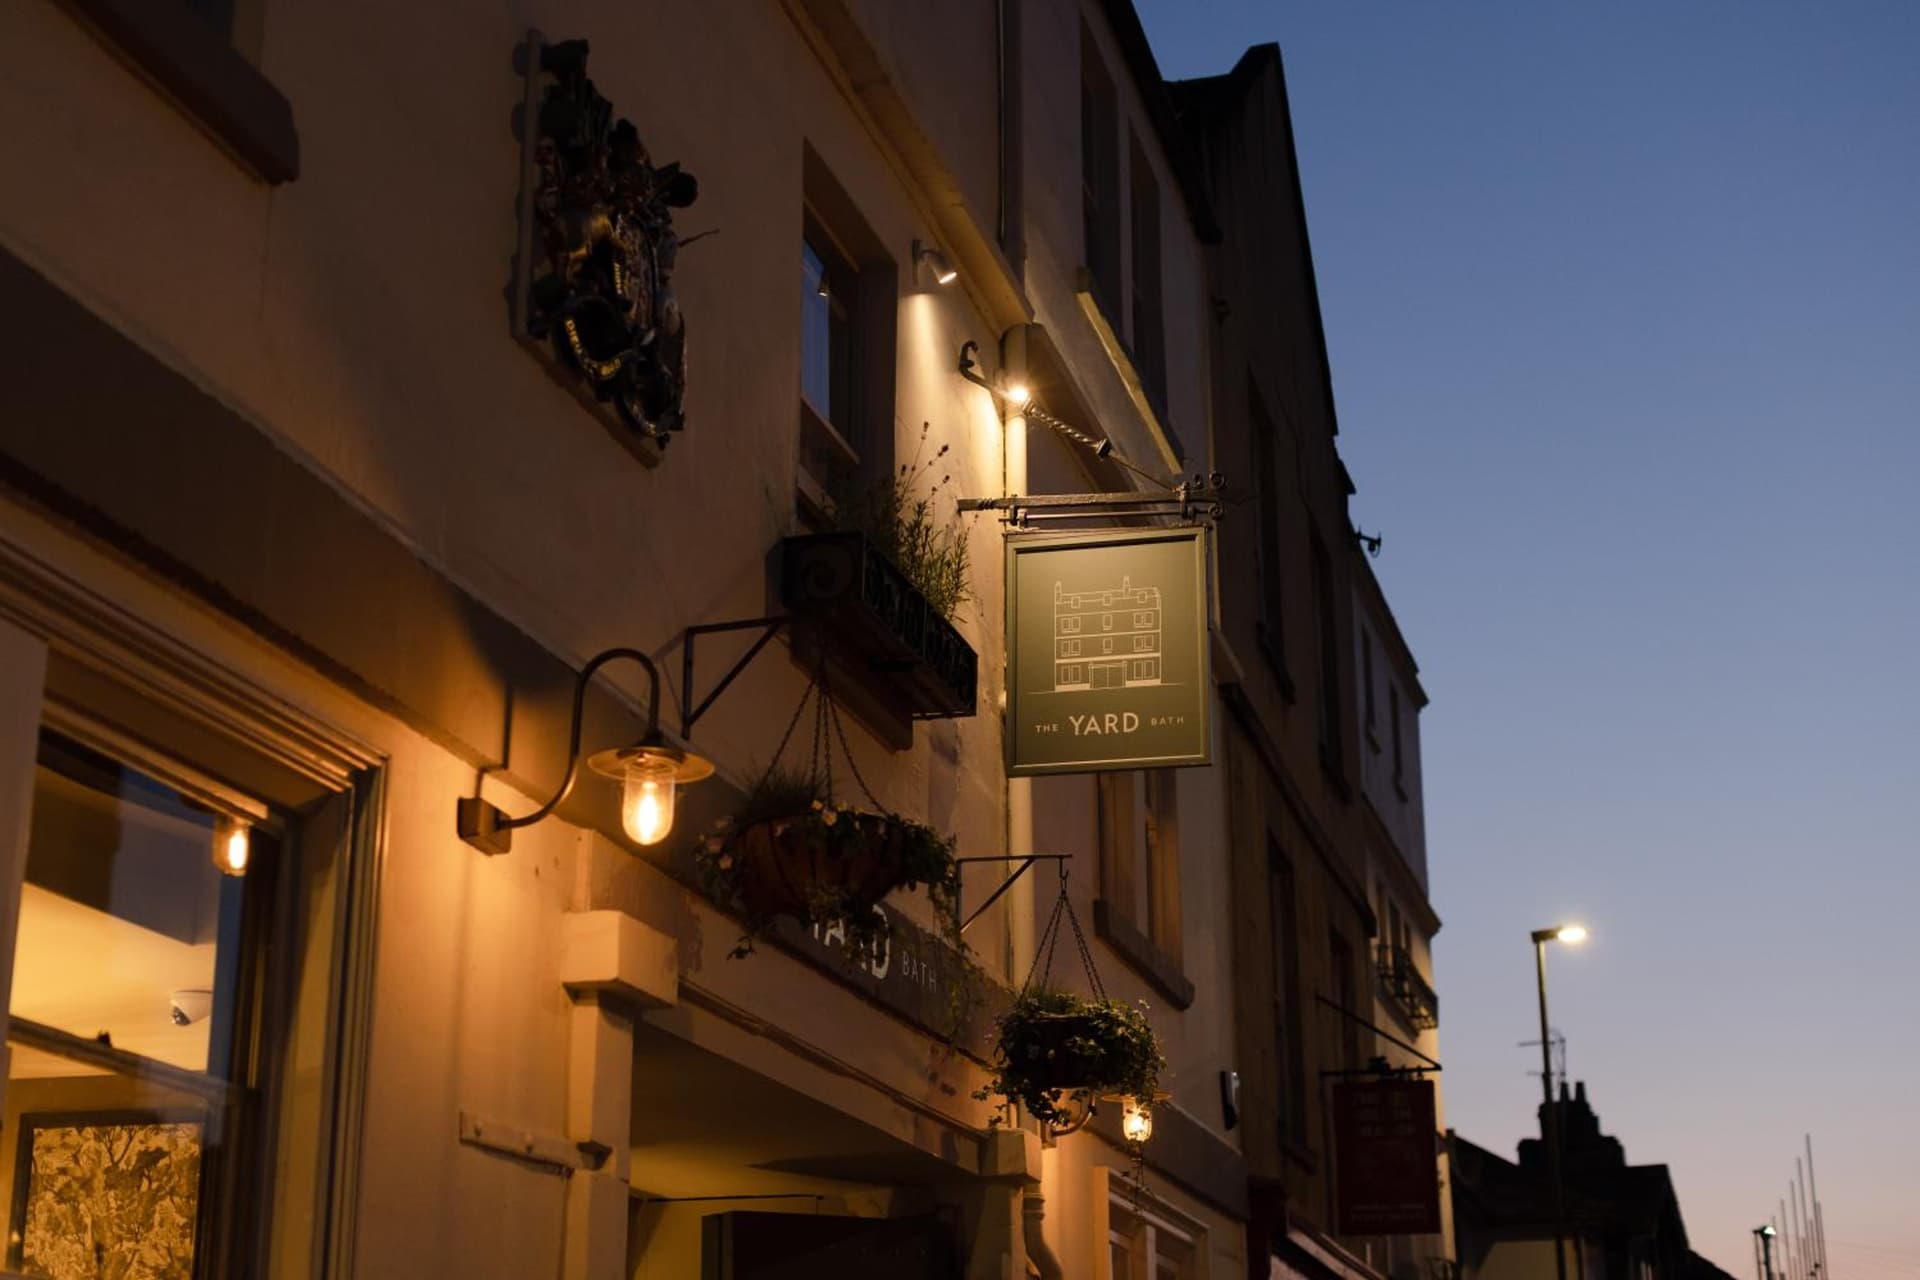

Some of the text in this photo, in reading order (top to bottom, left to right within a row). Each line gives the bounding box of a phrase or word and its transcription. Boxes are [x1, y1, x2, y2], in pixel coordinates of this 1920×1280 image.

[1035, 711, 1185, 736] THE YARD BATH
[902, 950, 937, 993] BATH
